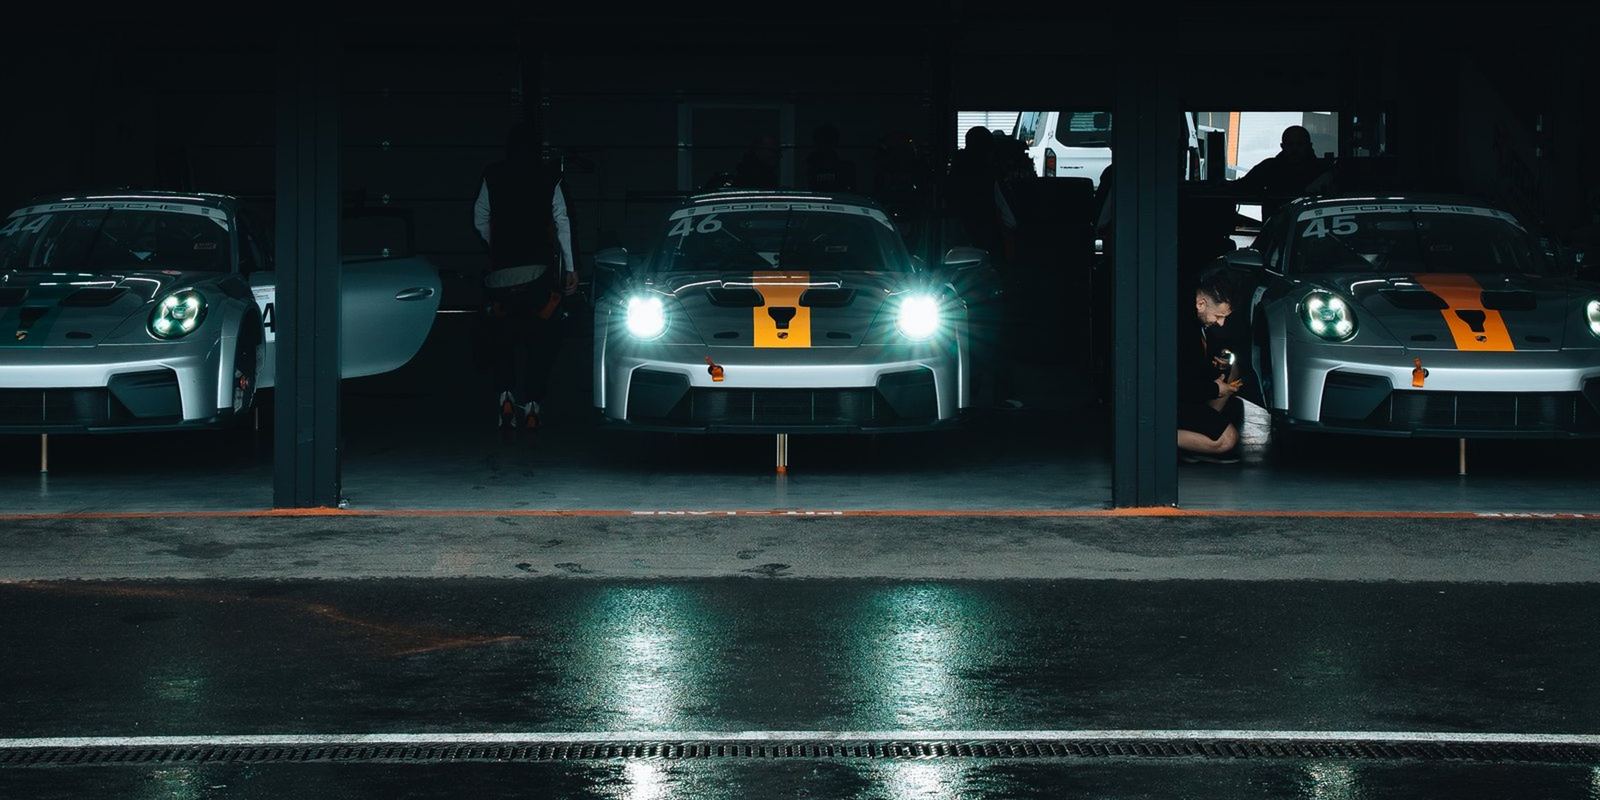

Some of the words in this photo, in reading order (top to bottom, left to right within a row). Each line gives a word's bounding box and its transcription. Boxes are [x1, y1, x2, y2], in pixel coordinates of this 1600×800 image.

[50, 203, 184, 212] PORSCHE
[712, 203, 845, 212] PORSCHE
[1340, 204, 1474, 213] PORSCHE
[0, 214, 53, 237] 44
[667, 214, 723, 237] 46
[1301, 215, 1359, 238] 45
